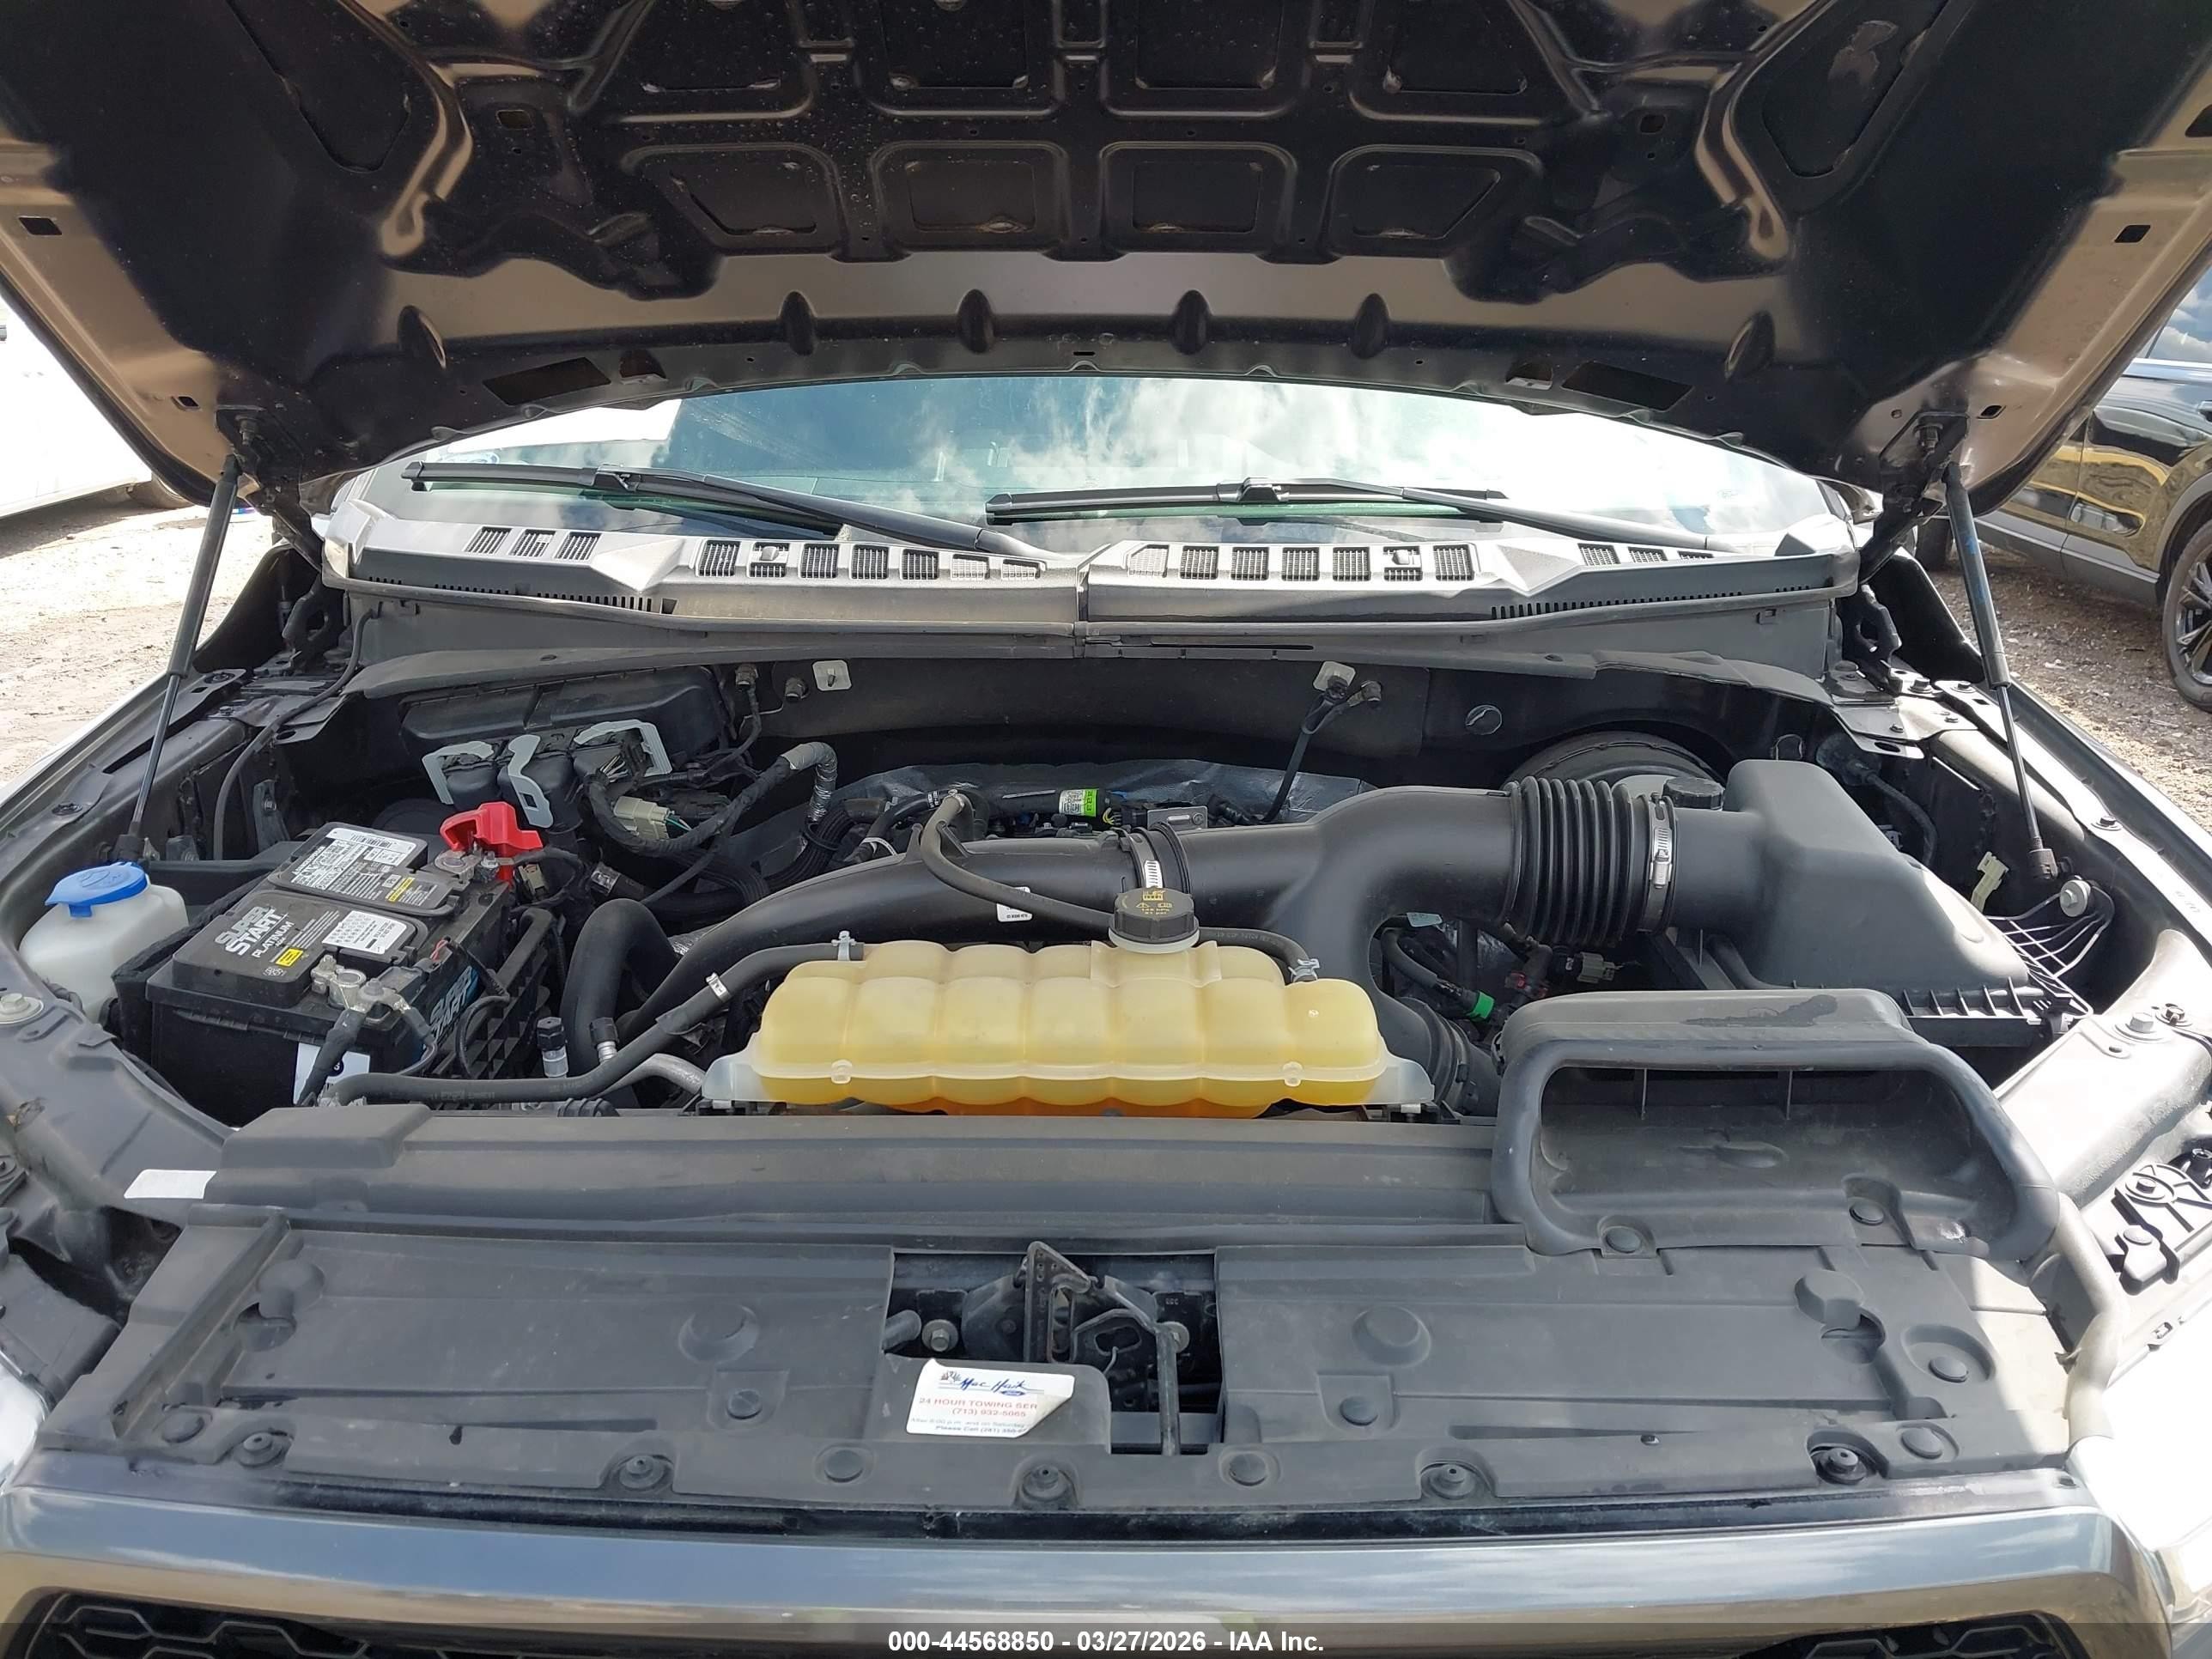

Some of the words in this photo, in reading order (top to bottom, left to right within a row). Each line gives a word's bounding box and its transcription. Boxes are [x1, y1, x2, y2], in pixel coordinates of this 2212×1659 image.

[215, 906, 272, 945] SUPER
[225, 908, 283, 956] START
[252, 921, 295, 958] PLATINUM
[952, 1407, 977, 1416] (713)
[969, 1400, 1012, 1408] TOWING
